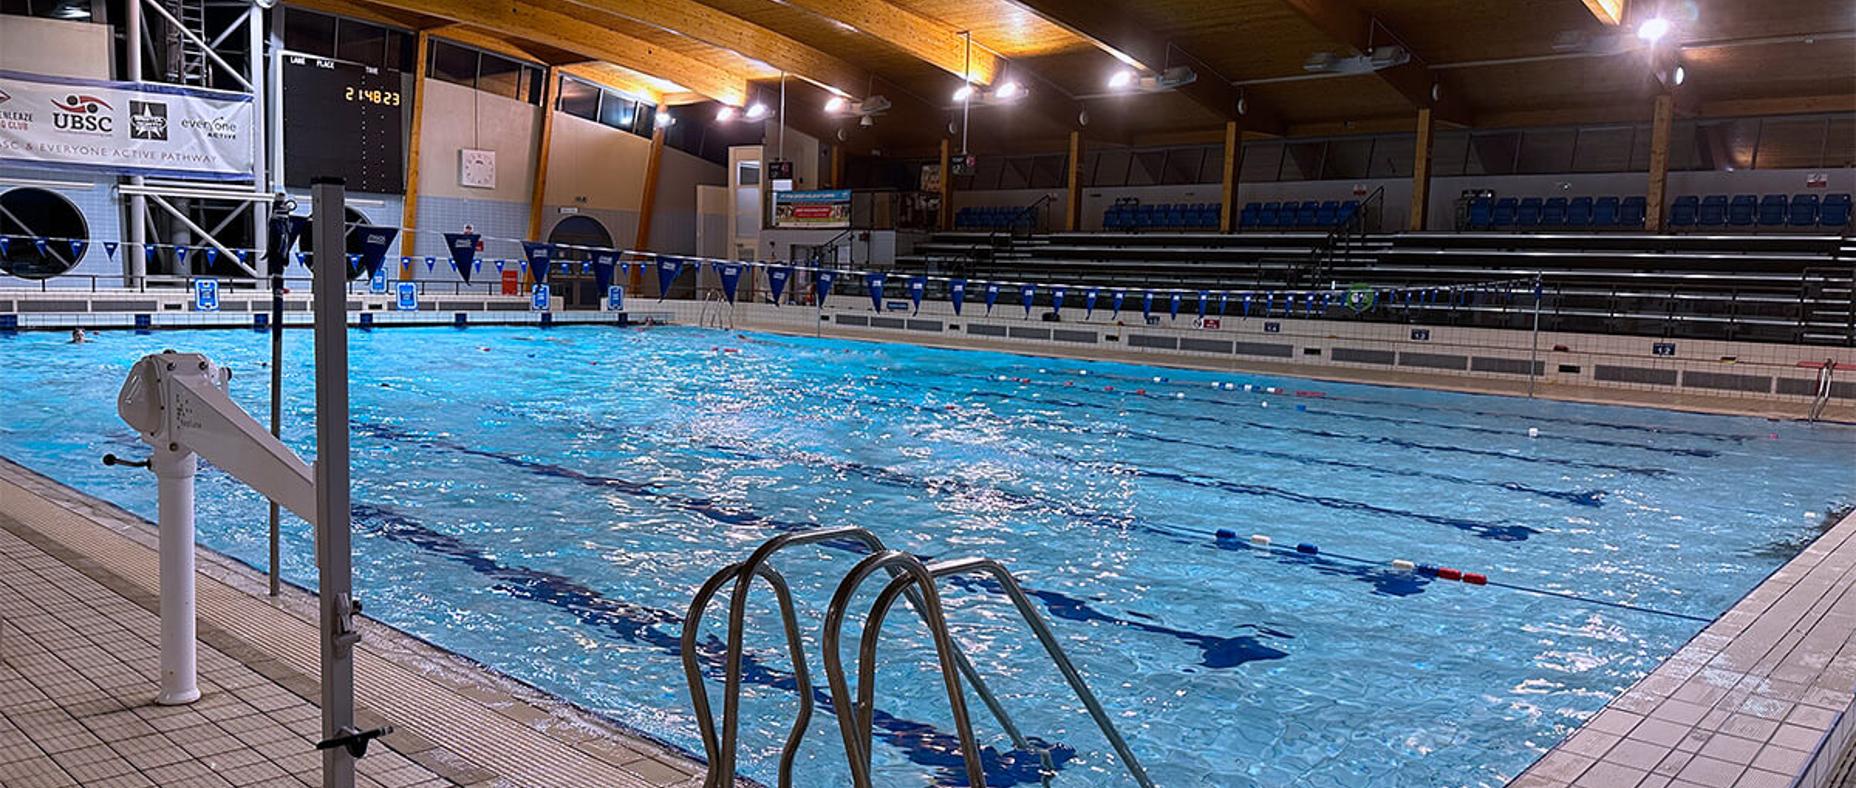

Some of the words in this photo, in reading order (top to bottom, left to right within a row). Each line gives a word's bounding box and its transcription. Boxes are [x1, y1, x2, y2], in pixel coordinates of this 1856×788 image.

[53, 112, 113, 132] UBSC
[181, 117, 236, 132] everyone
[207, 132, 236, 140] ACTIVE
[0, 140, 20, 150] SC
[40, 143, 108, 157] EVERYONE
[113, 148, 155, 159] ACTIVE
[161, 151, 217, 163] PATHWAY
